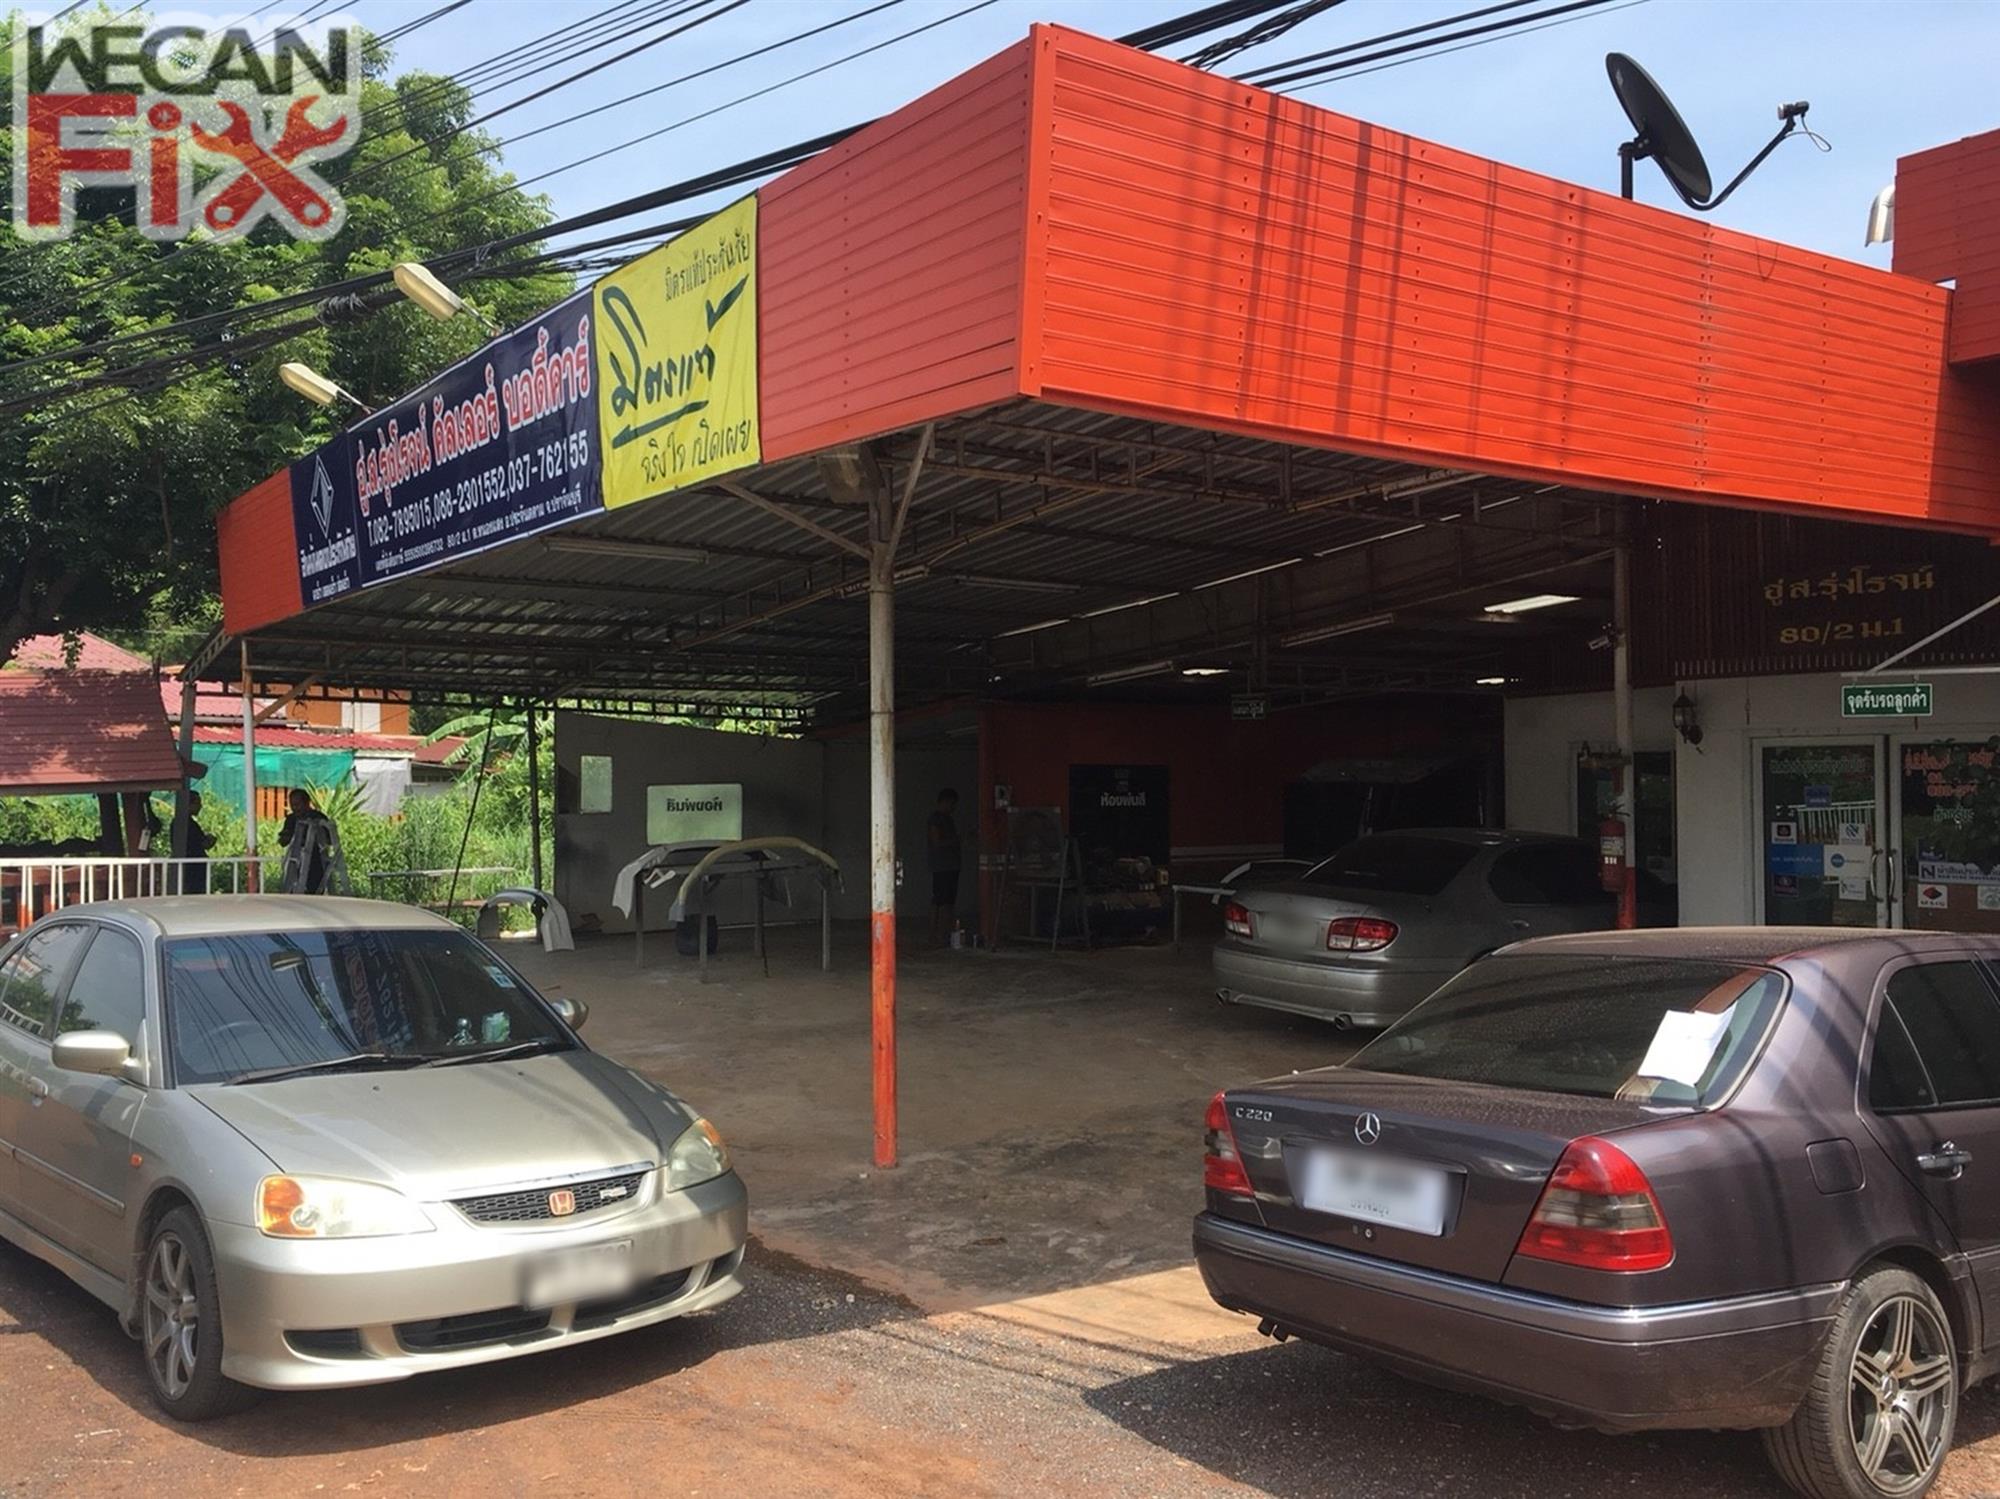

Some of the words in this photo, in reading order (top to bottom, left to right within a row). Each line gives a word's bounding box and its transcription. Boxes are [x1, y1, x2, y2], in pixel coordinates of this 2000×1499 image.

[1780, 621, 1853, 645] 80/2
[1860, 617, 1906, 639] ม.1
[1847, 686, 1928, 714] จุดรับรถลูกค้า
